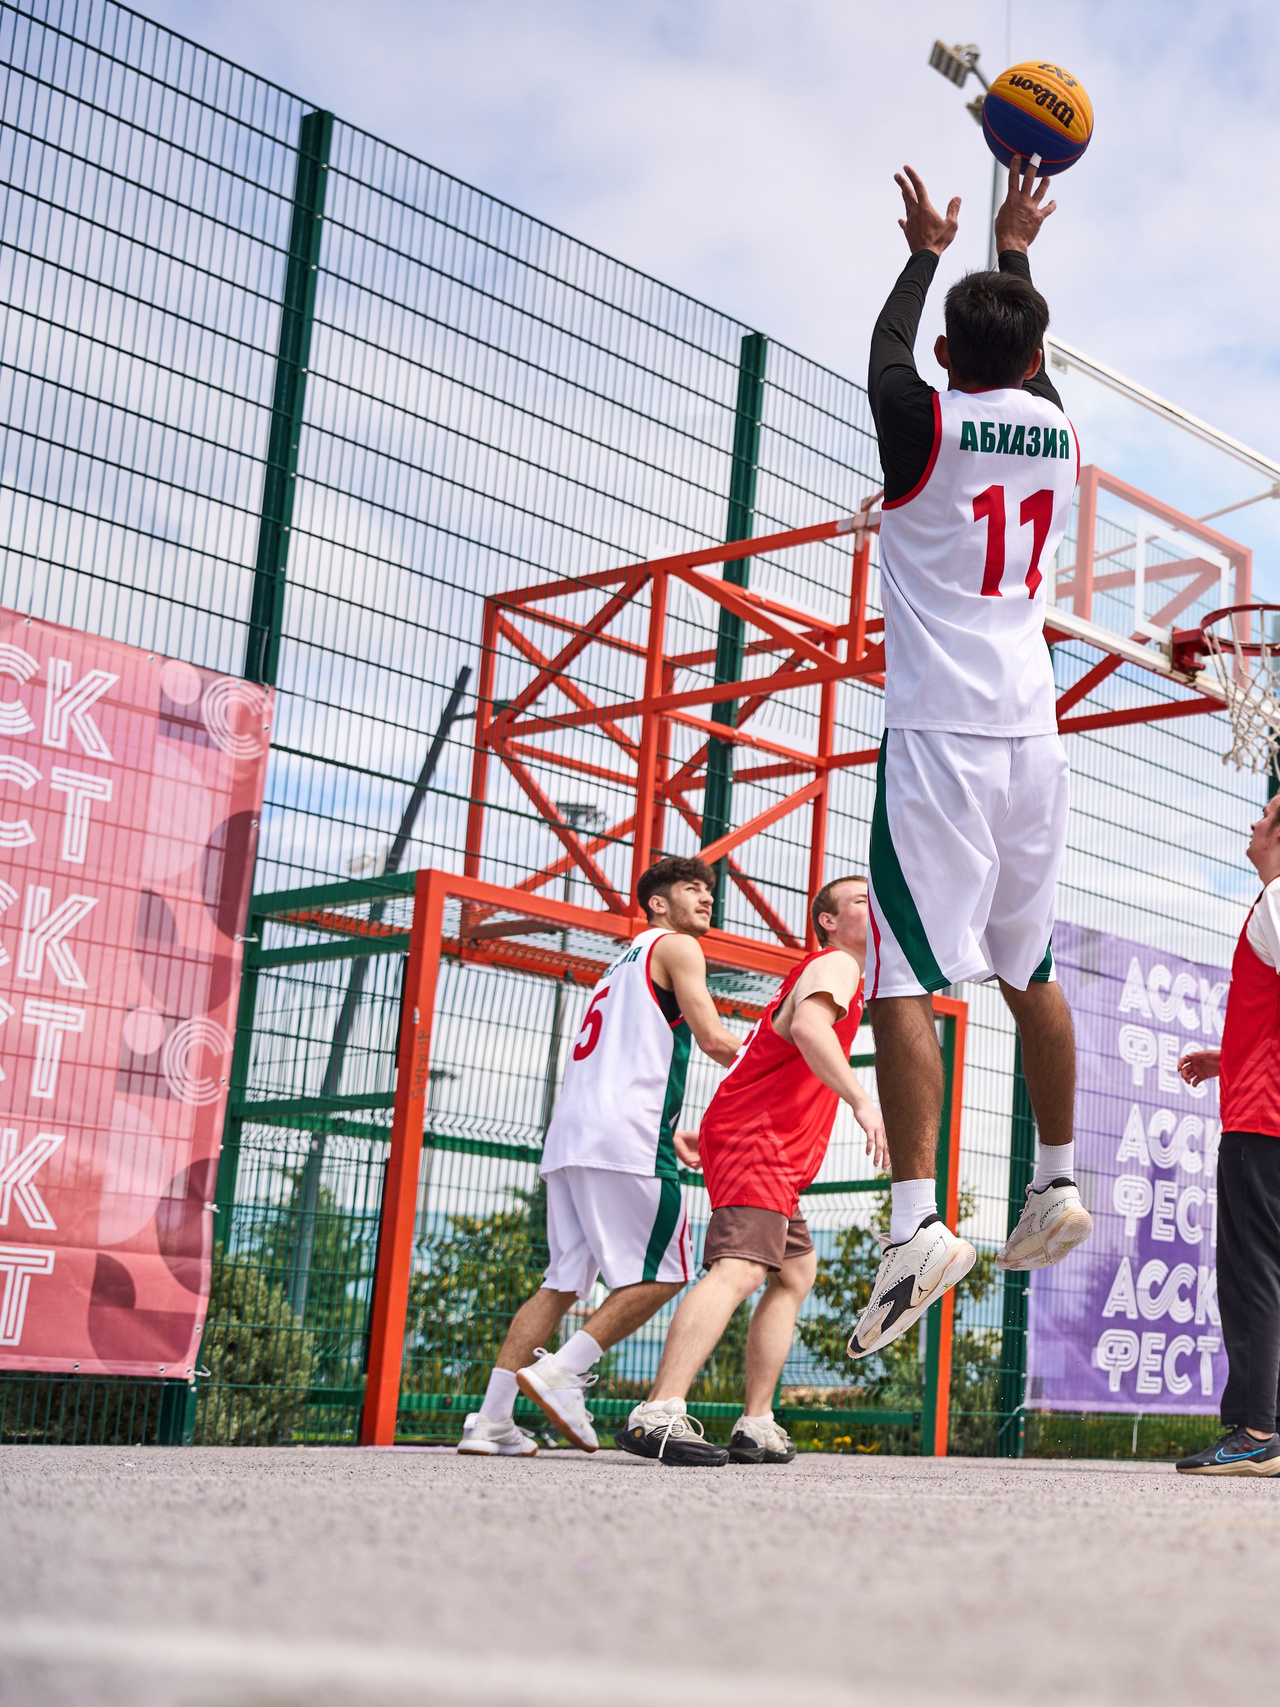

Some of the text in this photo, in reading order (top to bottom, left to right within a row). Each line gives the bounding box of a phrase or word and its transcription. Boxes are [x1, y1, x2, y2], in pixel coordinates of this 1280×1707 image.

[1008, 74, 1075, 129] Wilson
[959, 420, 1070, 460] АБХАЗИЯ
[972, 484, 1055, 600] 11
[572, 985, 611, 1062] 5
[1101, 1256, 1222, 1326] АССК
[1097, 1328, 1221, 1396] ФЕСТ
